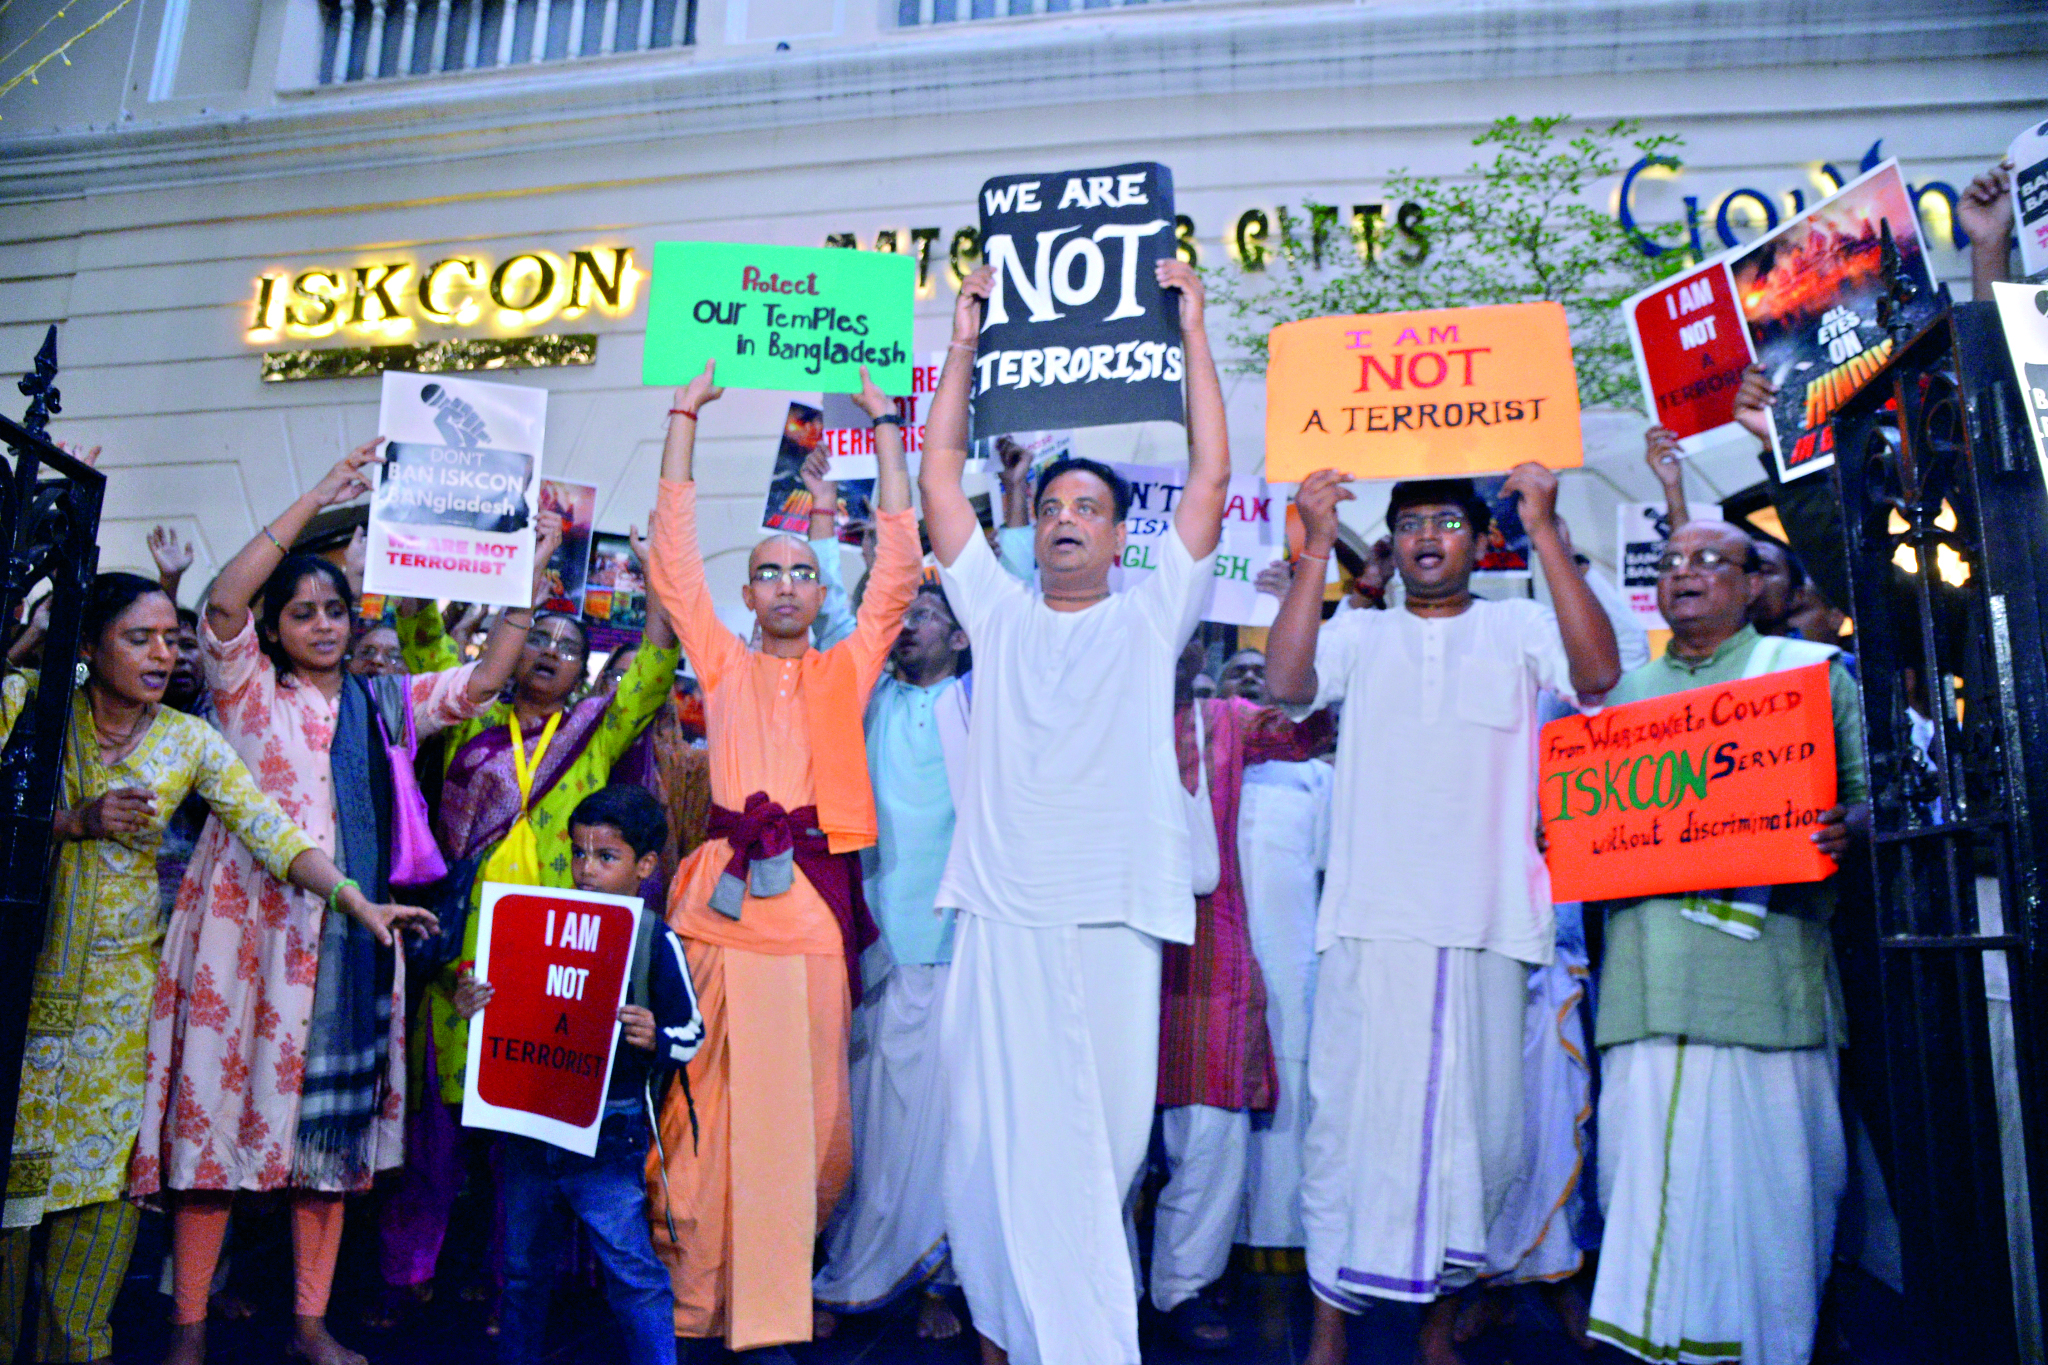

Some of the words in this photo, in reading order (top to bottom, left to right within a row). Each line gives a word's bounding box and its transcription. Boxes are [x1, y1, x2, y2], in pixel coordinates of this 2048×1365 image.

[984, 181, 1042, 216] WE
[1057, 172, 1149, 209] ARE
[247, 247, 634, 331] ISKCON
[742, 265, 820, 296] Protect
[980, 218, 1171, 334] NOT
[1665, 293, 1678, 321] I
[1679, 277, 1715, 316] AM
[1821, 304, 1848, 327] ALL
[1345, 330, 1371, 349] I
[1395, 325, 1460, 346] AM
[1679, 315, 1717, 351] NOT
[1818, 311, 1861, 345] EYES
[737, 333, 756, 356] in
[768, 331, 906, 375] Bangladesh
[1702, 351, 1716, 370] A
[1828, 329, 1864, 365] ON
[976, 339, 1183, 396] TERRORISTS
[1352, 347, 1491, 394] NOT
[1659, 366, 1743, 410] TERROR
[1301, 409, 1330, 434] A
[1342, 396, 1550, 434] TERRORIST
[431, 447, 485, 466] DON'T
[388, 462, 434, 484] BAN
[440, 467, 524, 494] ISKCON
[387, 551, 507, 575] TERRORIST
[428, 537, 469, 554] ARE
[475, 543, 519, 559] NOT
[1546, 742, 1715, 823] ISKCON
[545, 909, 556, 946] I
[559, 912, 601, 953] AM
[546, 964, 590, 1001] NOT
[555, 1012, 569, 1036] A
[487, 1036, 606, 1078] TERRORIST
